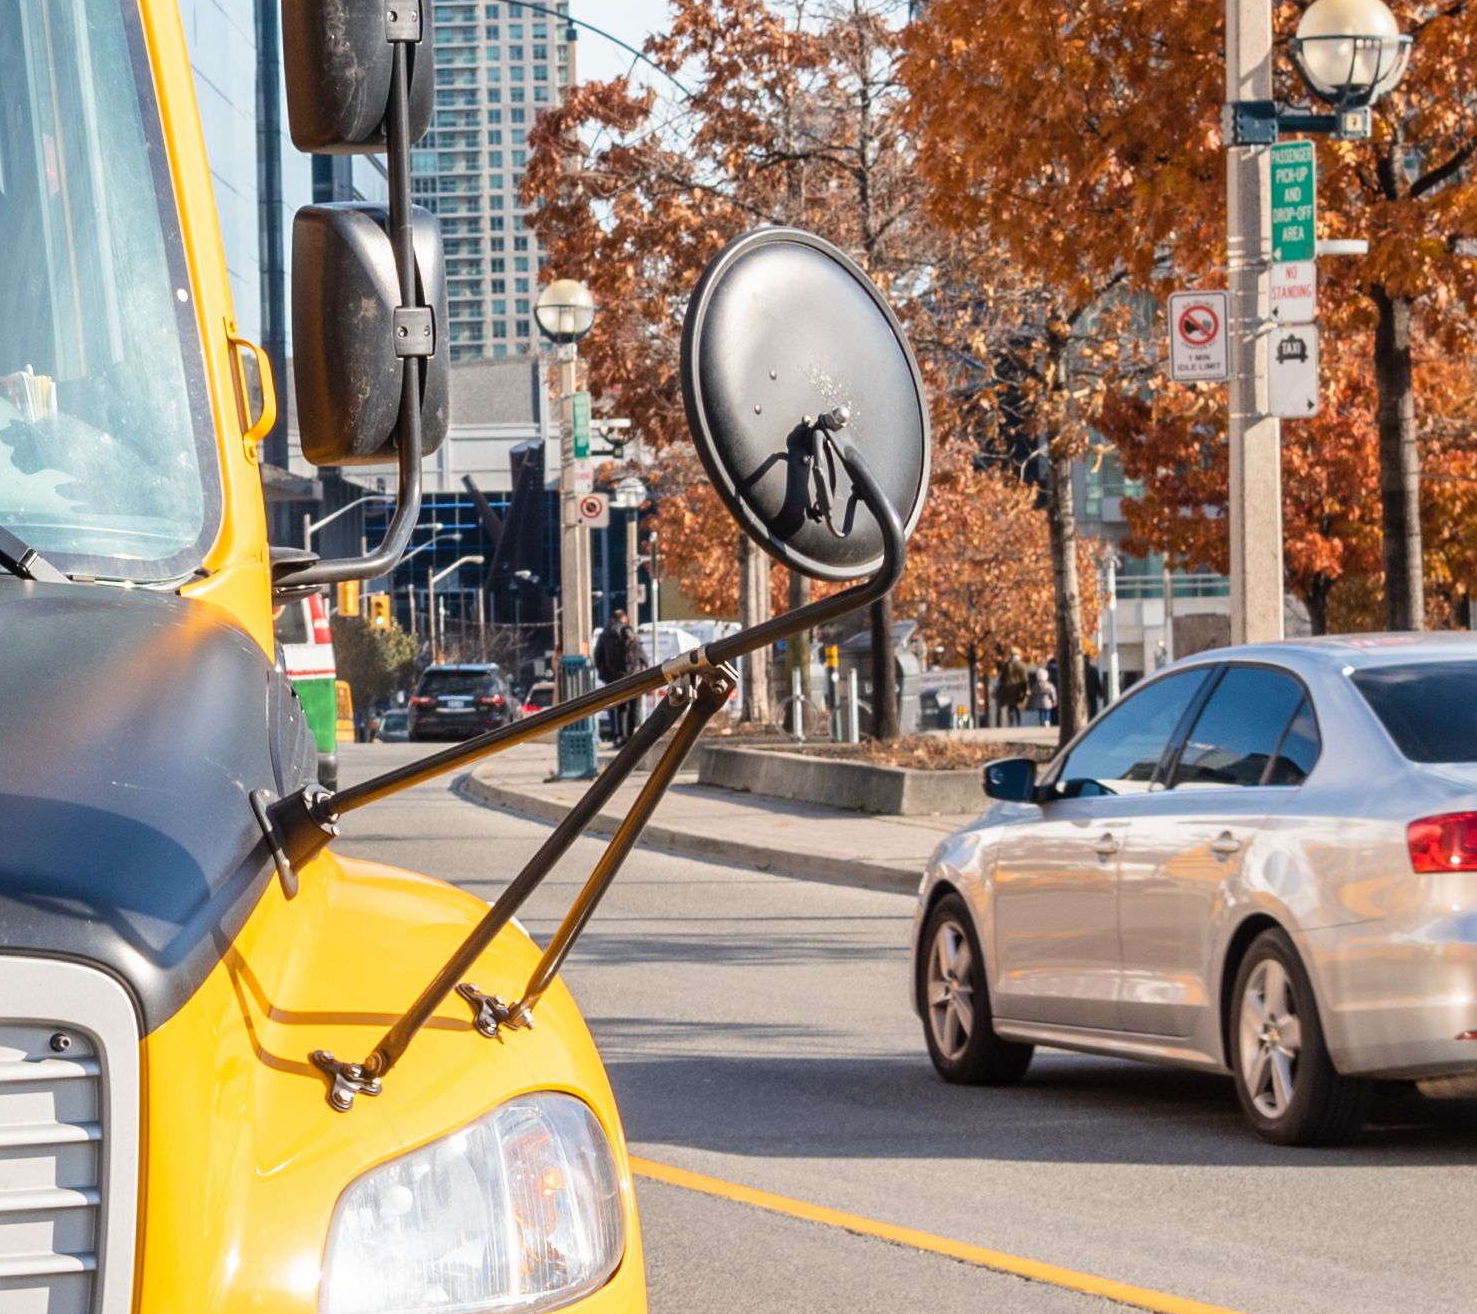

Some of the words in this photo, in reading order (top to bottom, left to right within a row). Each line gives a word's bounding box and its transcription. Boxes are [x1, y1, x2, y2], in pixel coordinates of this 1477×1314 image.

[1271, 147, 1313, 164] PASSENGER
[1275, 166, 1308, 184] PICK-UP
[1284, 186, 1302, 203] AND
[1273, 205, 1313, 223] DROP-OFF
[1282, 226, 1305, 242] AREA
[1285, 266, 1298, 280] NO
[1271, 283, 1312, 301] STANDING
[1281, 341, 1302, 355] TAXI
[1195, 354, 1211, 362] MIN
[1177, 364, 1196, 372] IDLE
[1199, 362, 1221, 371] LIMIT
